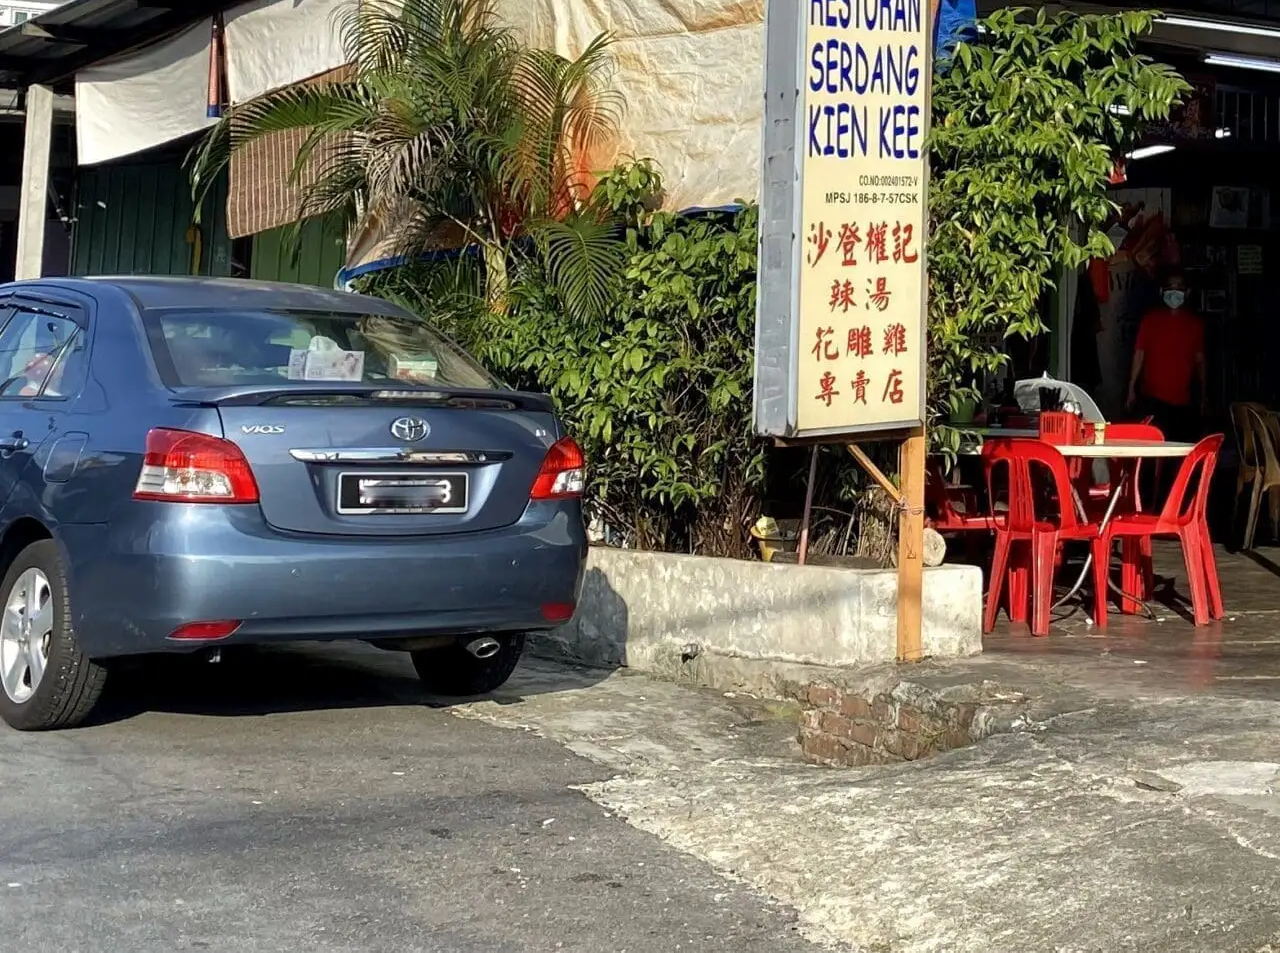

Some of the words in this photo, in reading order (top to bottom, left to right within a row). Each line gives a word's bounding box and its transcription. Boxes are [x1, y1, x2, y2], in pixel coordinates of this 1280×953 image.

[809, 39, 920, 96] SERDANG
[809, 103, 868, 158] KIEN
[879, 105, 920, 159] KEE
[825, 192, 851, 204] MPSJ
[806, 221, 919, 268] 沙登權記
[828, 276, 892, 313] 辣湯
[811, 322, 908, 362] 花雕雞
[815, 369, 905, 408] 專賣店
[241, 425, 286, 435] VIOS
